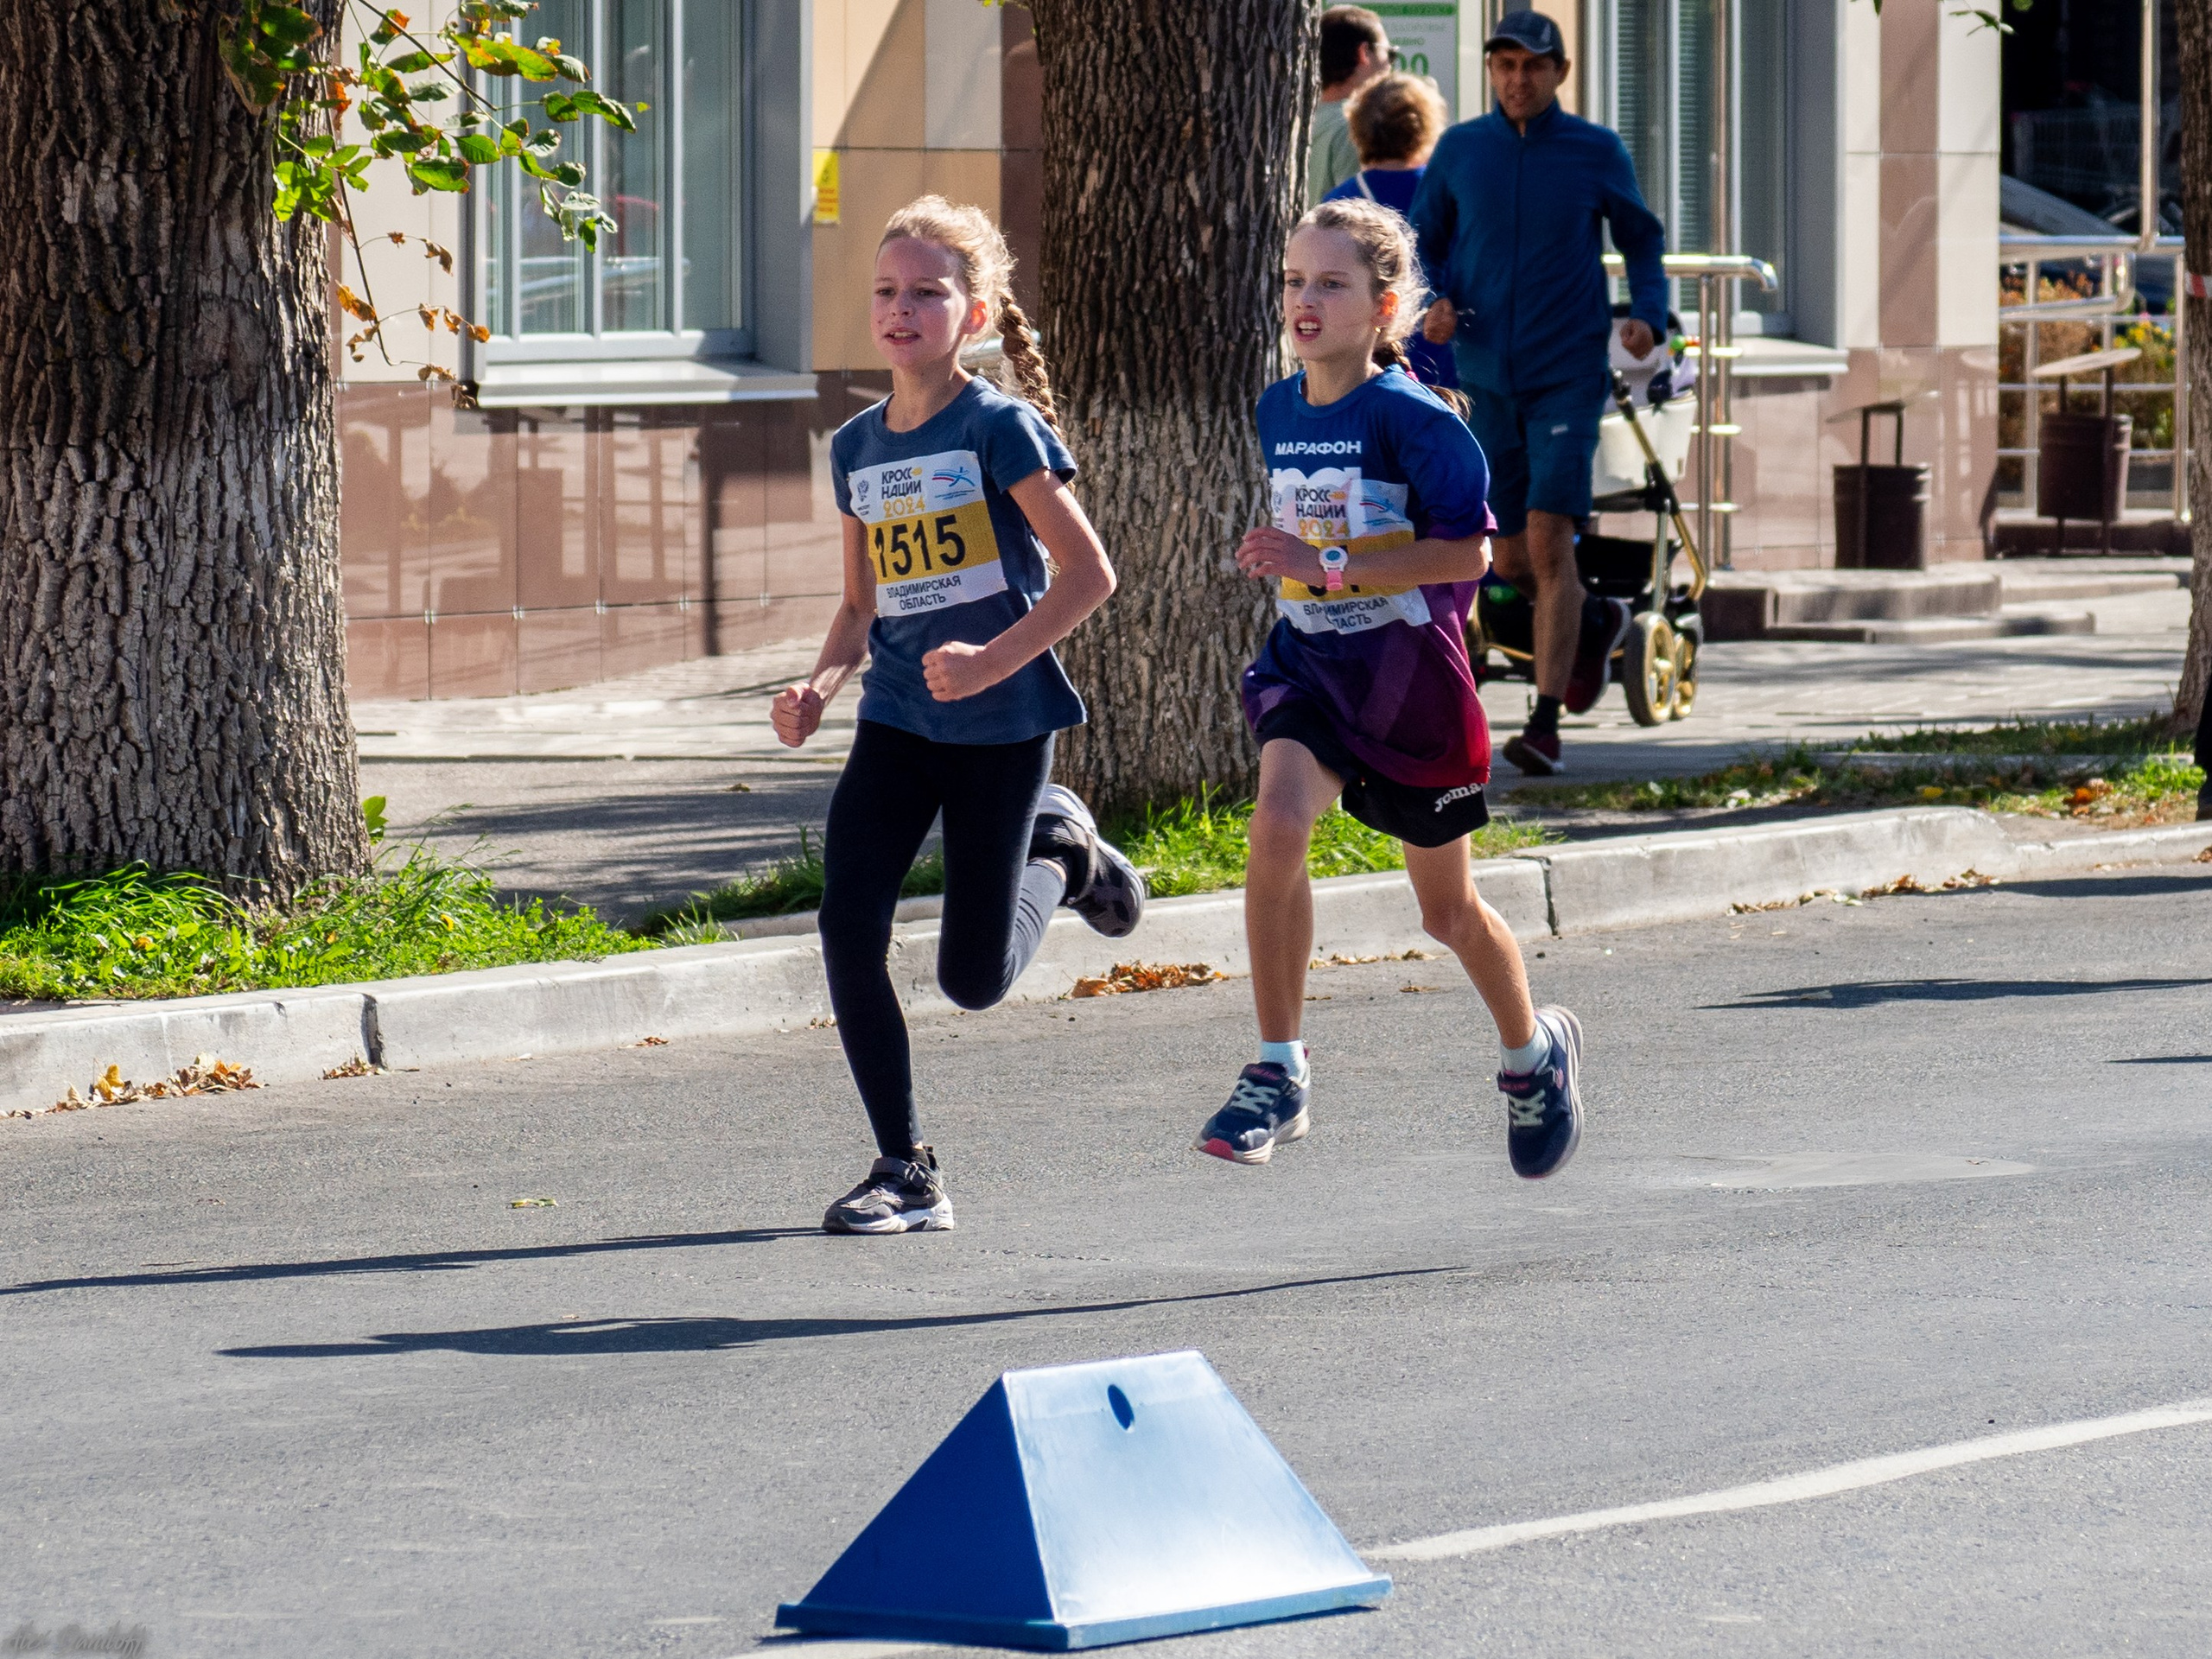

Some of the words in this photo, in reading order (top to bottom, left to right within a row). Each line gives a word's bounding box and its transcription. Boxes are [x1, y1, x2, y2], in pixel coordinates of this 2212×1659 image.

[1274, 441, 1362, 455] МАРАФОН
[881, 467, 912, 482] КРОСС
[880, 480, 922, 499] НАЦИИ
[1295, 487, 1331, 502] КРОСС
[883, 496, 925, 518] 2024
[1295, 504, 1347, 519] НАЦИИ
[1298, 518, 1351, 537] 2024
[874, 514, 965, 578] 1515
[899, 593, 946, 610] ОБЛАСТЬ
